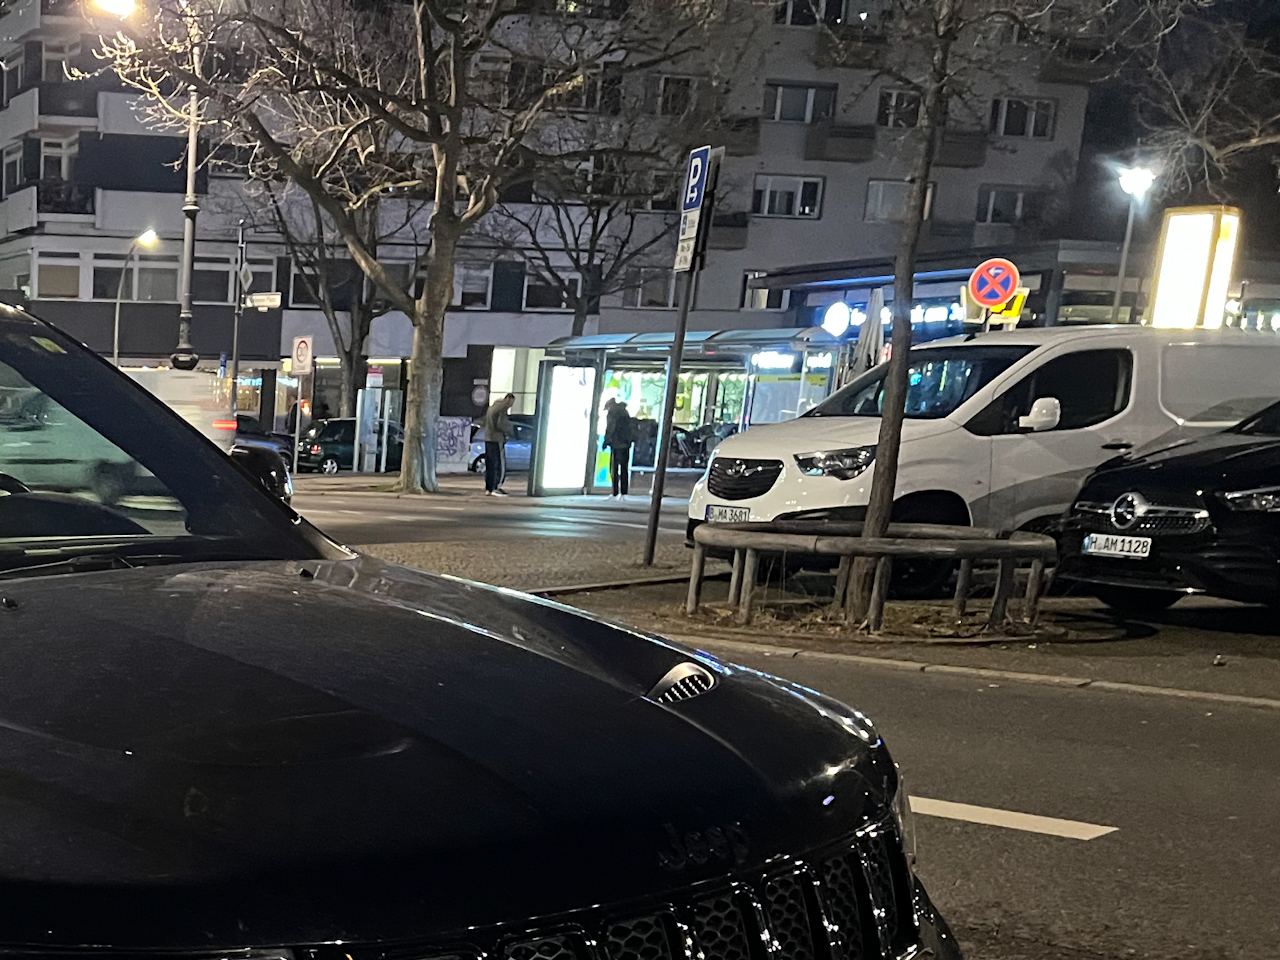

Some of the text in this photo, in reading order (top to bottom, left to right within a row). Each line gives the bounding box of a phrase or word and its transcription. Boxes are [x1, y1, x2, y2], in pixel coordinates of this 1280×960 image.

[1090, 536, 1149, 553] H AM 1128
